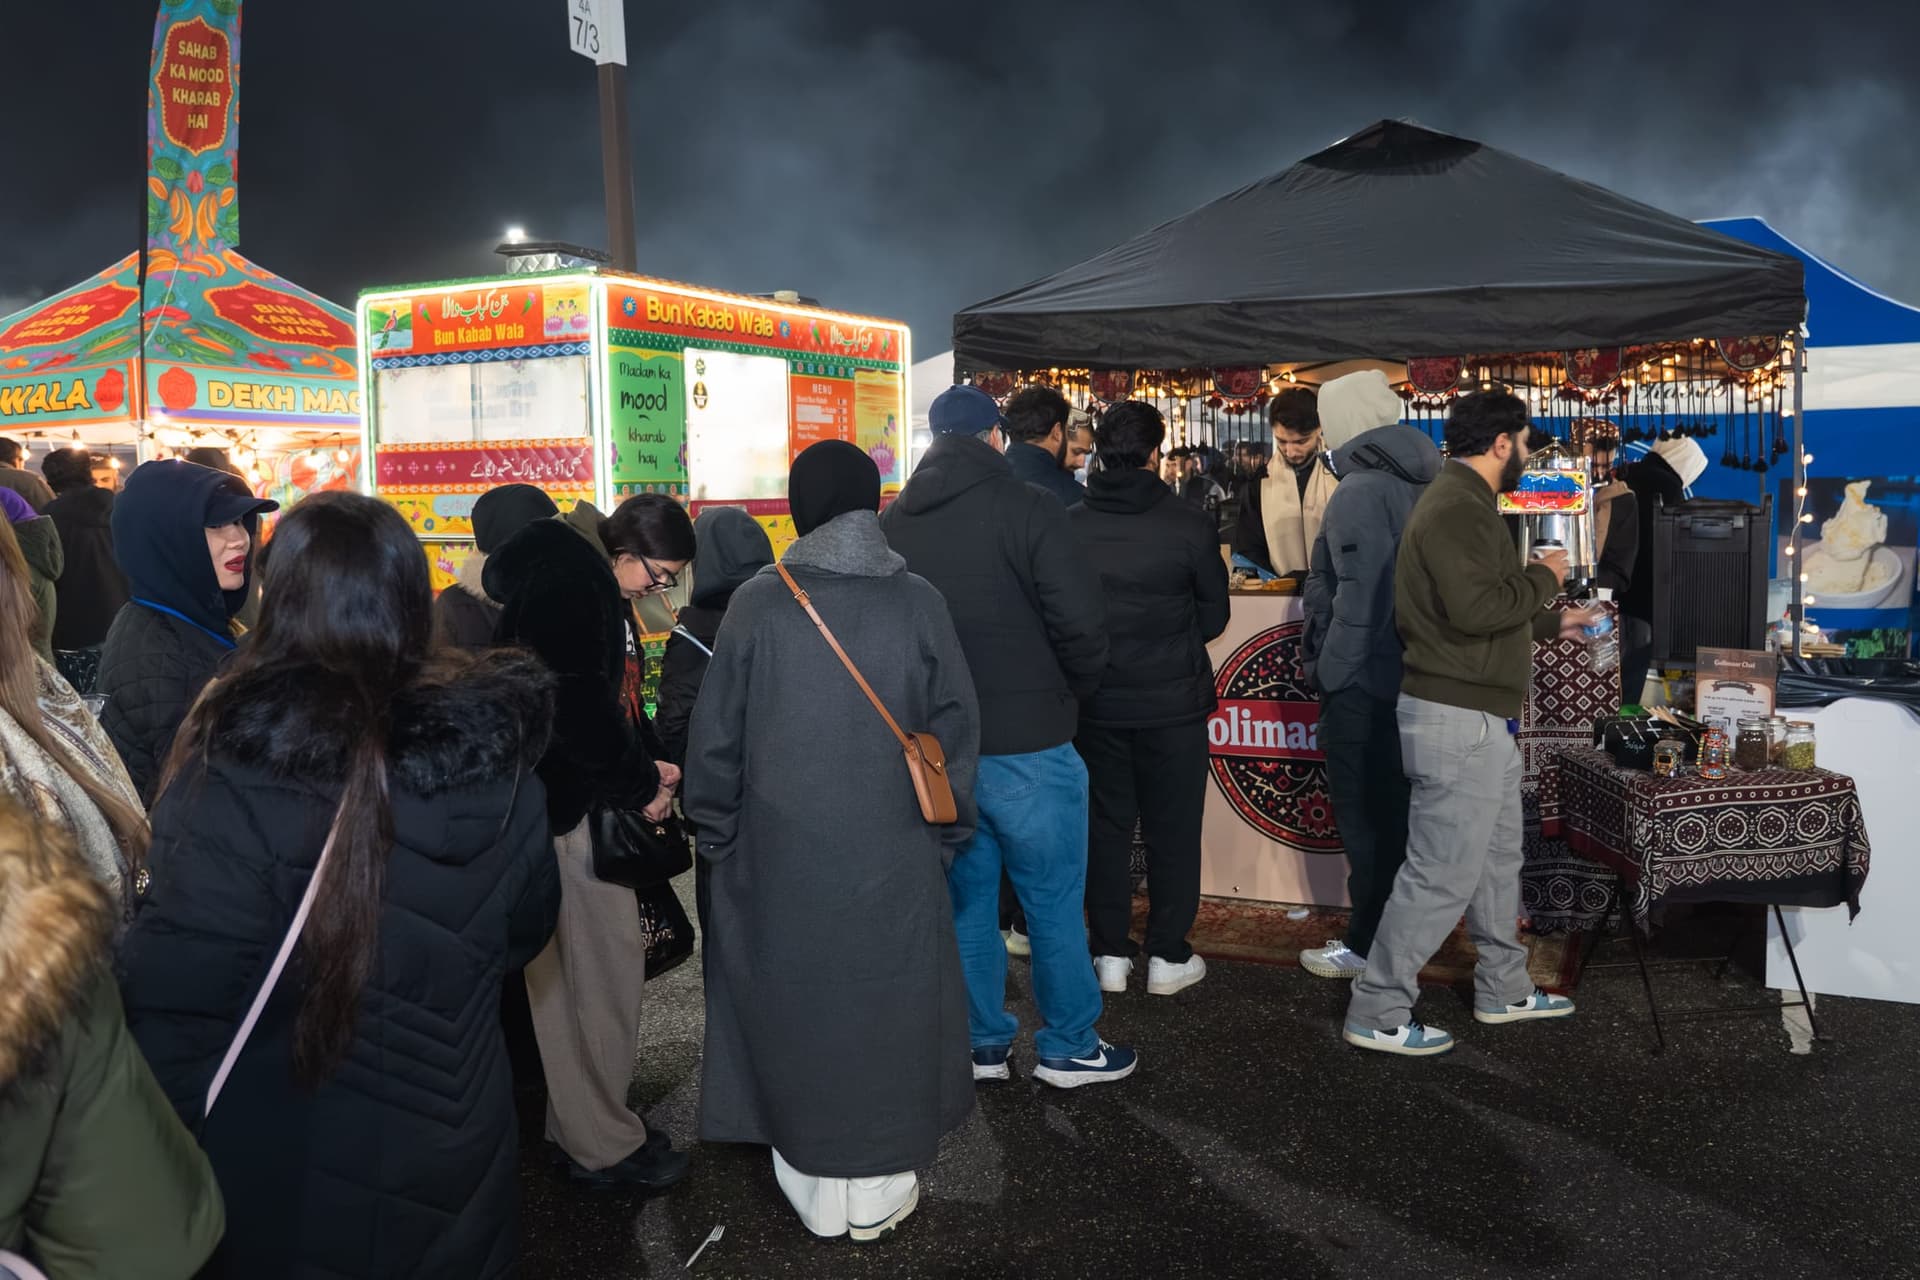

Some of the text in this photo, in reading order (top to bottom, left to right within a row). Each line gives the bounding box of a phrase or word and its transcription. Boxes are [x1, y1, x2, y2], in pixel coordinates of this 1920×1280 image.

[178, 40, 217, 60] SAHAB
[170, 63, 224, 83] KA MOOD
[172, 87, 221, 107] KHARAB
[187, 113, 208, 129] HAI
[252, 303, 303, 316] BUN
[646, 294, 774, 338] Bun Kabab Wala
[250, 314, 329, 329] KABAB
[271, 325, 337, 339] WALA
[434, 322, 525, 346] Bun Kabab Wala
[618, 361, 672, 381] Madam ka
[0, 378, 93, 416] WALA
[207, 380, 296, 412] DEKH
[620, 384, 668, 412] mood
[812, 383, 833, 395] MENU
[628, 426, 667, 444] kharab
[638, 449, 658, 471] hay
